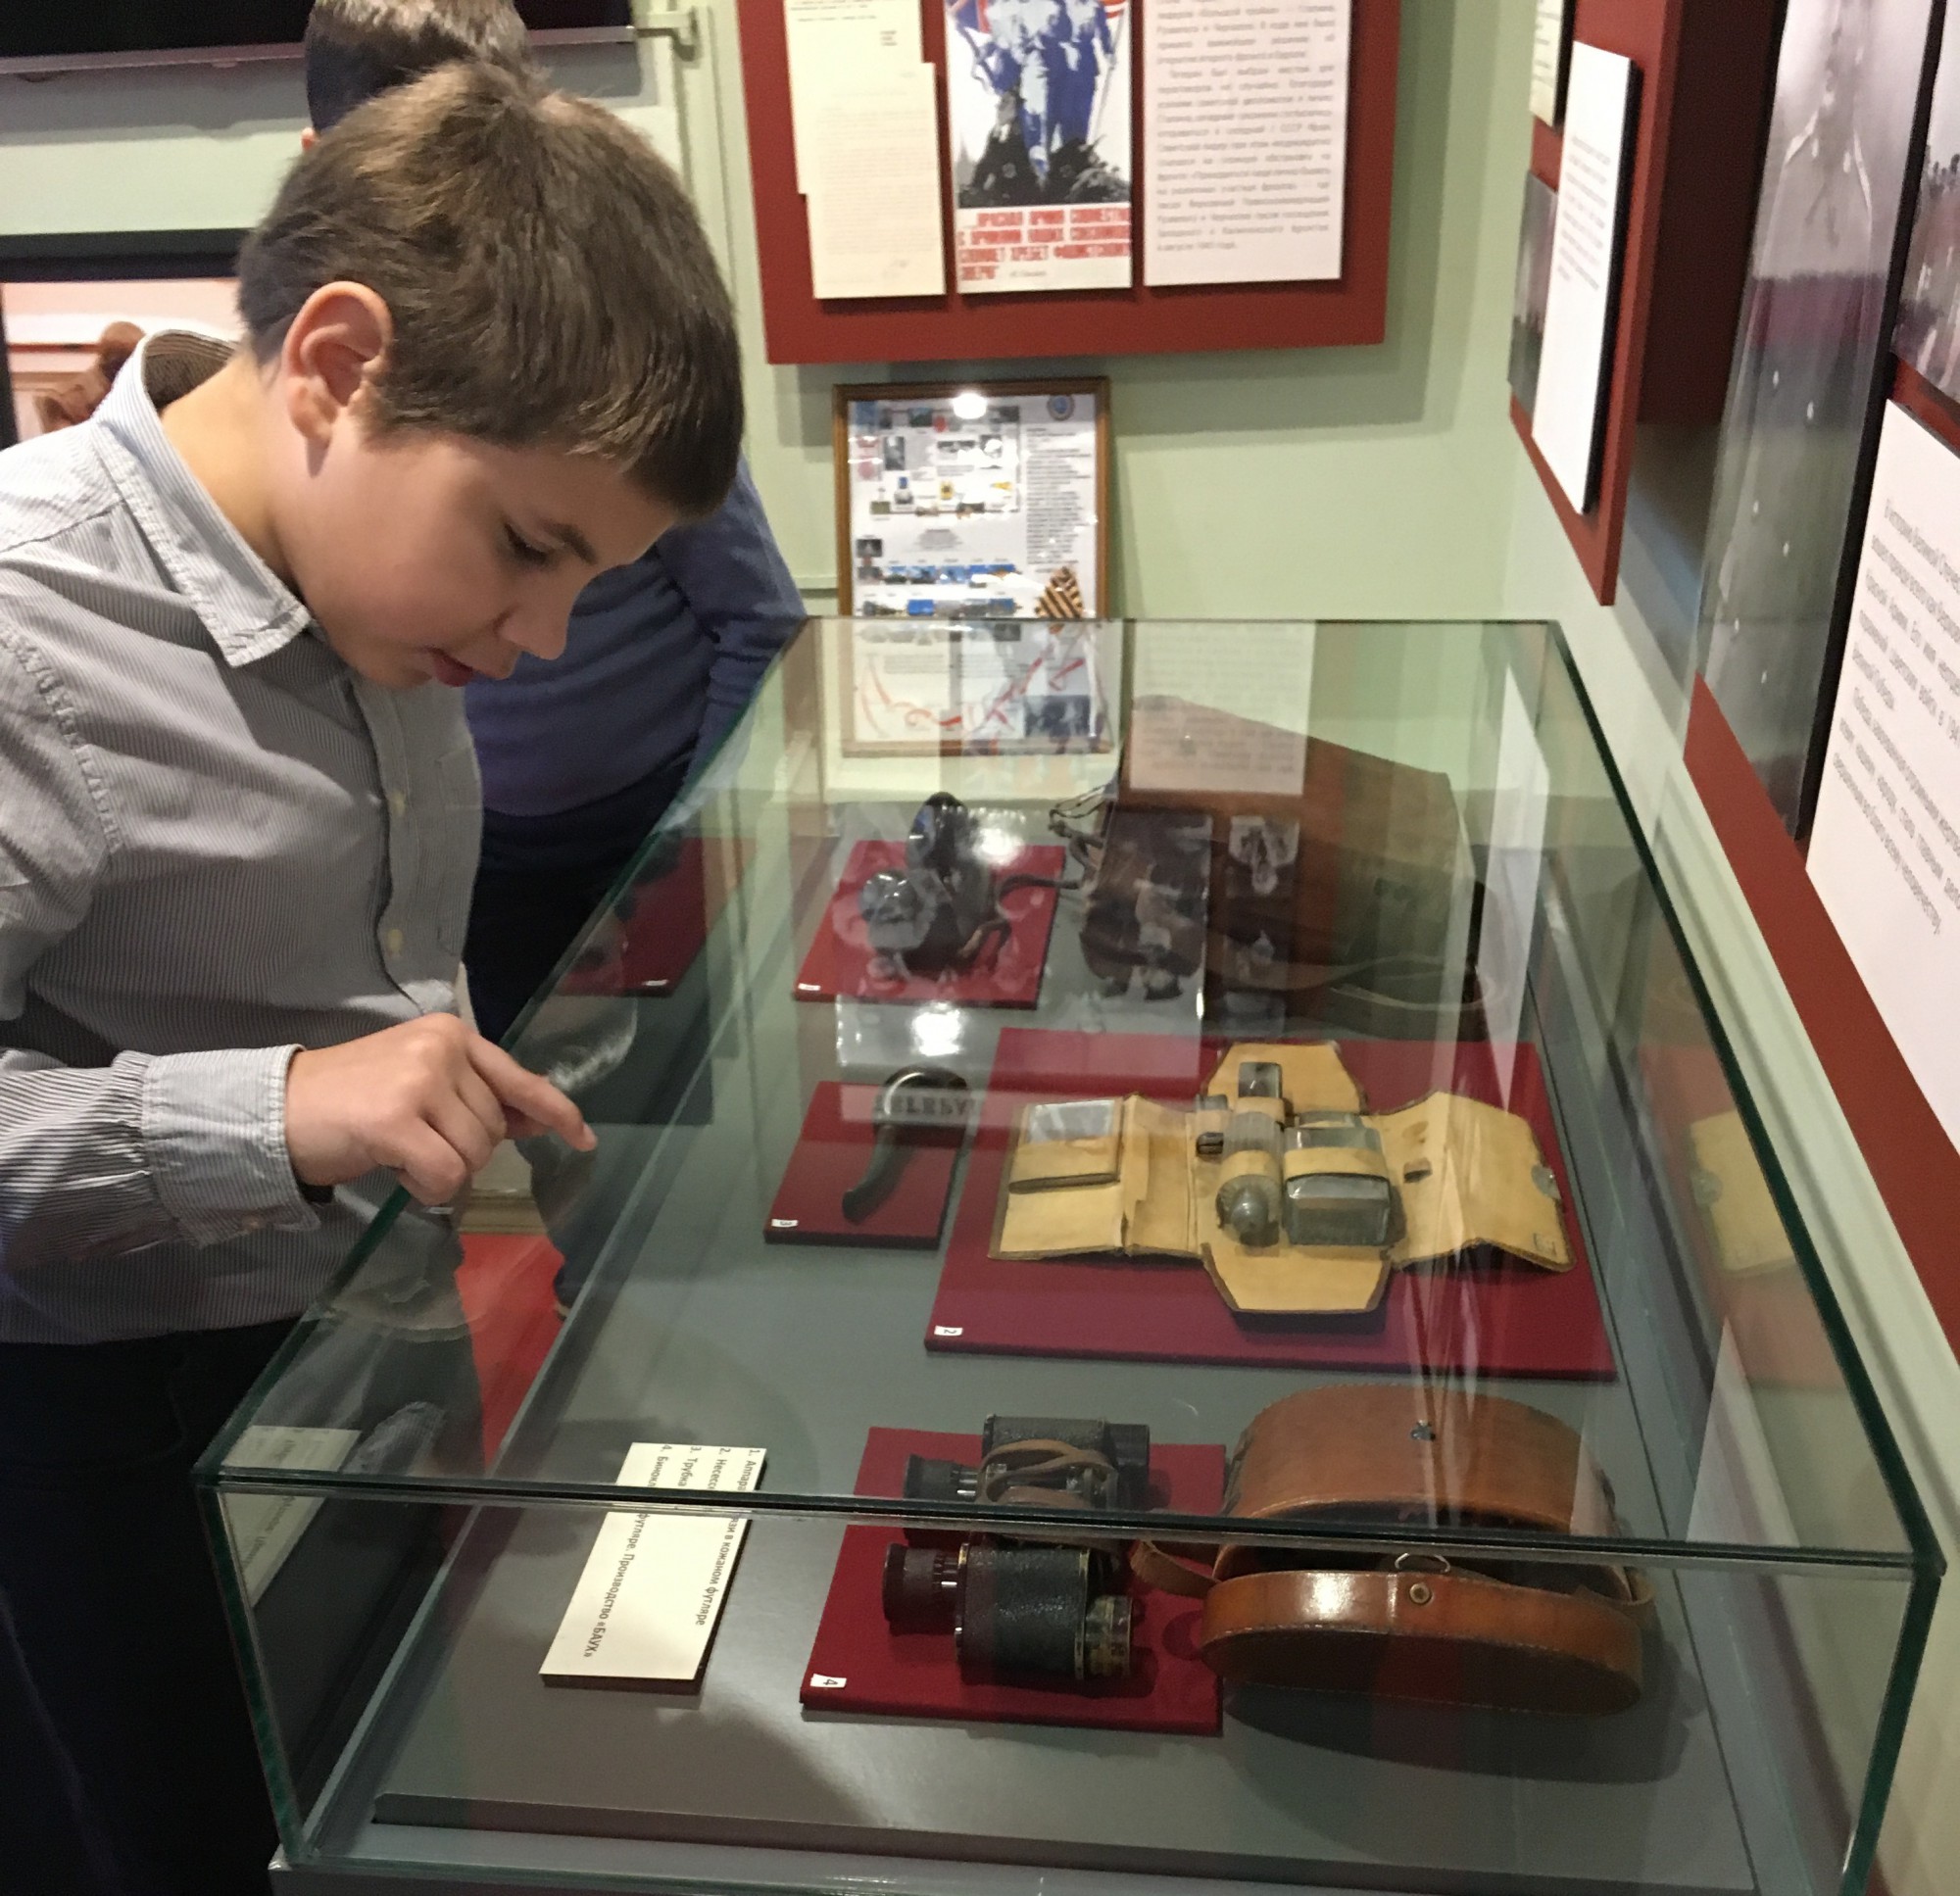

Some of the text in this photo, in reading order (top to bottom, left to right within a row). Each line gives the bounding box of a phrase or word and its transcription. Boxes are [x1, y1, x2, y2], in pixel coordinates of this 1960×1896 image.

[647, 1456, 669, 1487] Бинокл
[677, 1458, 699, 1487] Трубка
[708, 1459, 727, 1489] Несесс
[737, 1460, 757, 1491] Аппара
[710, 1541, 731, 1585] кожаном
[598, 1553, 635, 1620] Производство
[695, 1586, 719, 1627] футляре
[583, 1622, 607, 1658] «БАУХ»
